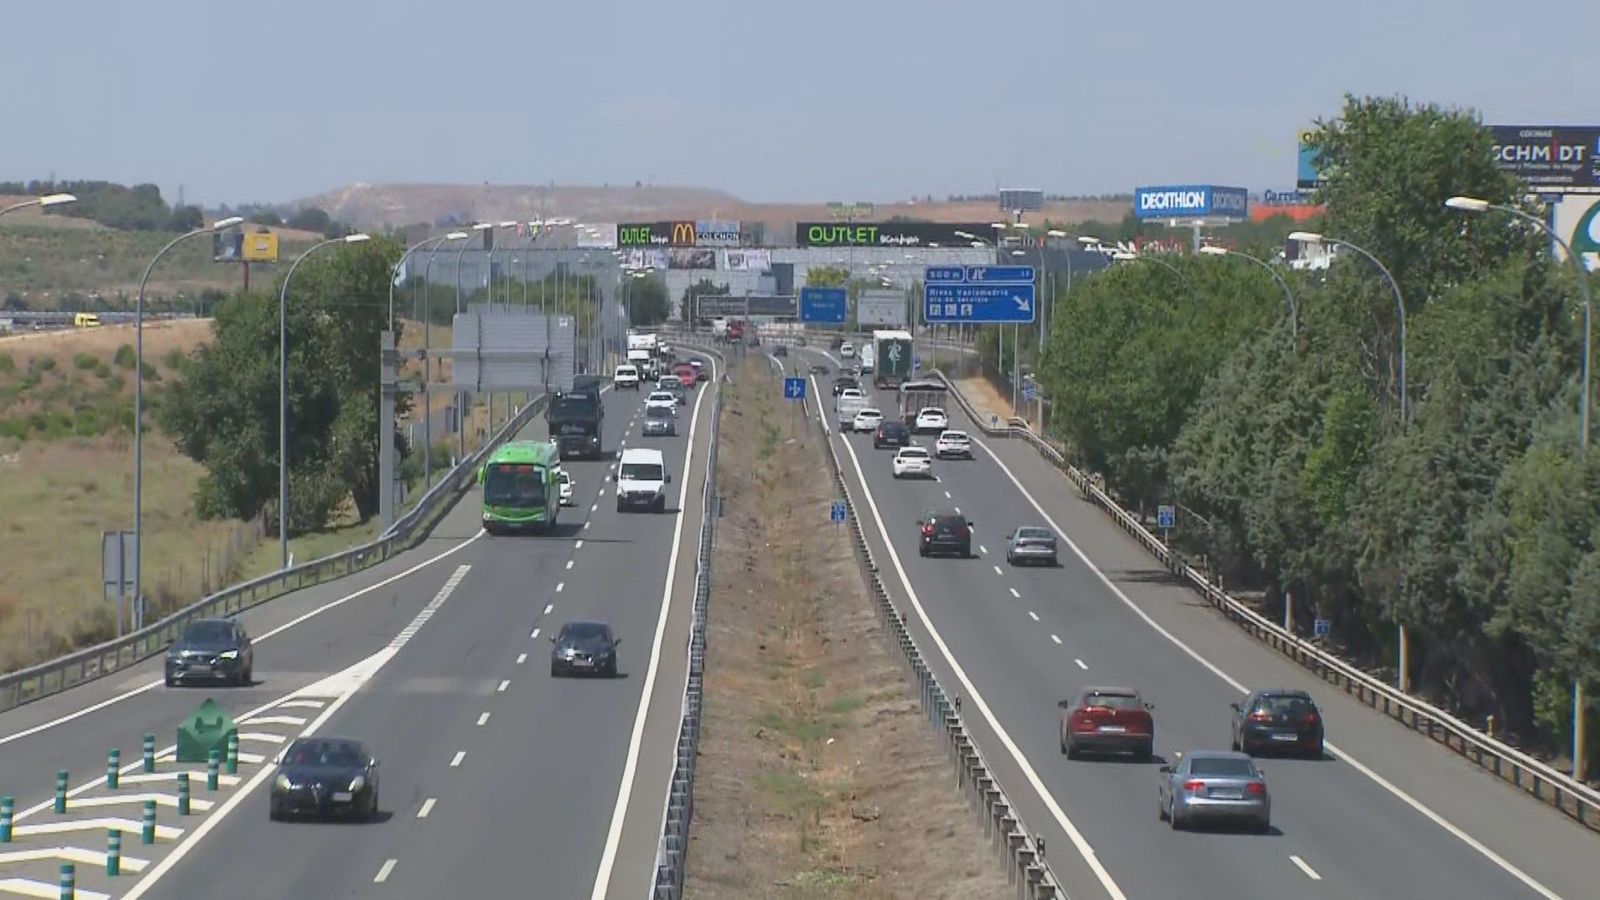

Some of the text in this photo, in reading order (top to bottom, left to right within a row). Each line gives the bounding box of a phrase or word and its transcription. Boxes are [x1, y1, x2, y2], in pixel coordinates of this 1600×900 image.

[1141, 191, 1205, 210] DECATHLON
[620, 227, 650, 244] OUTLET
[808, 226, 877, 243] OUTLET
